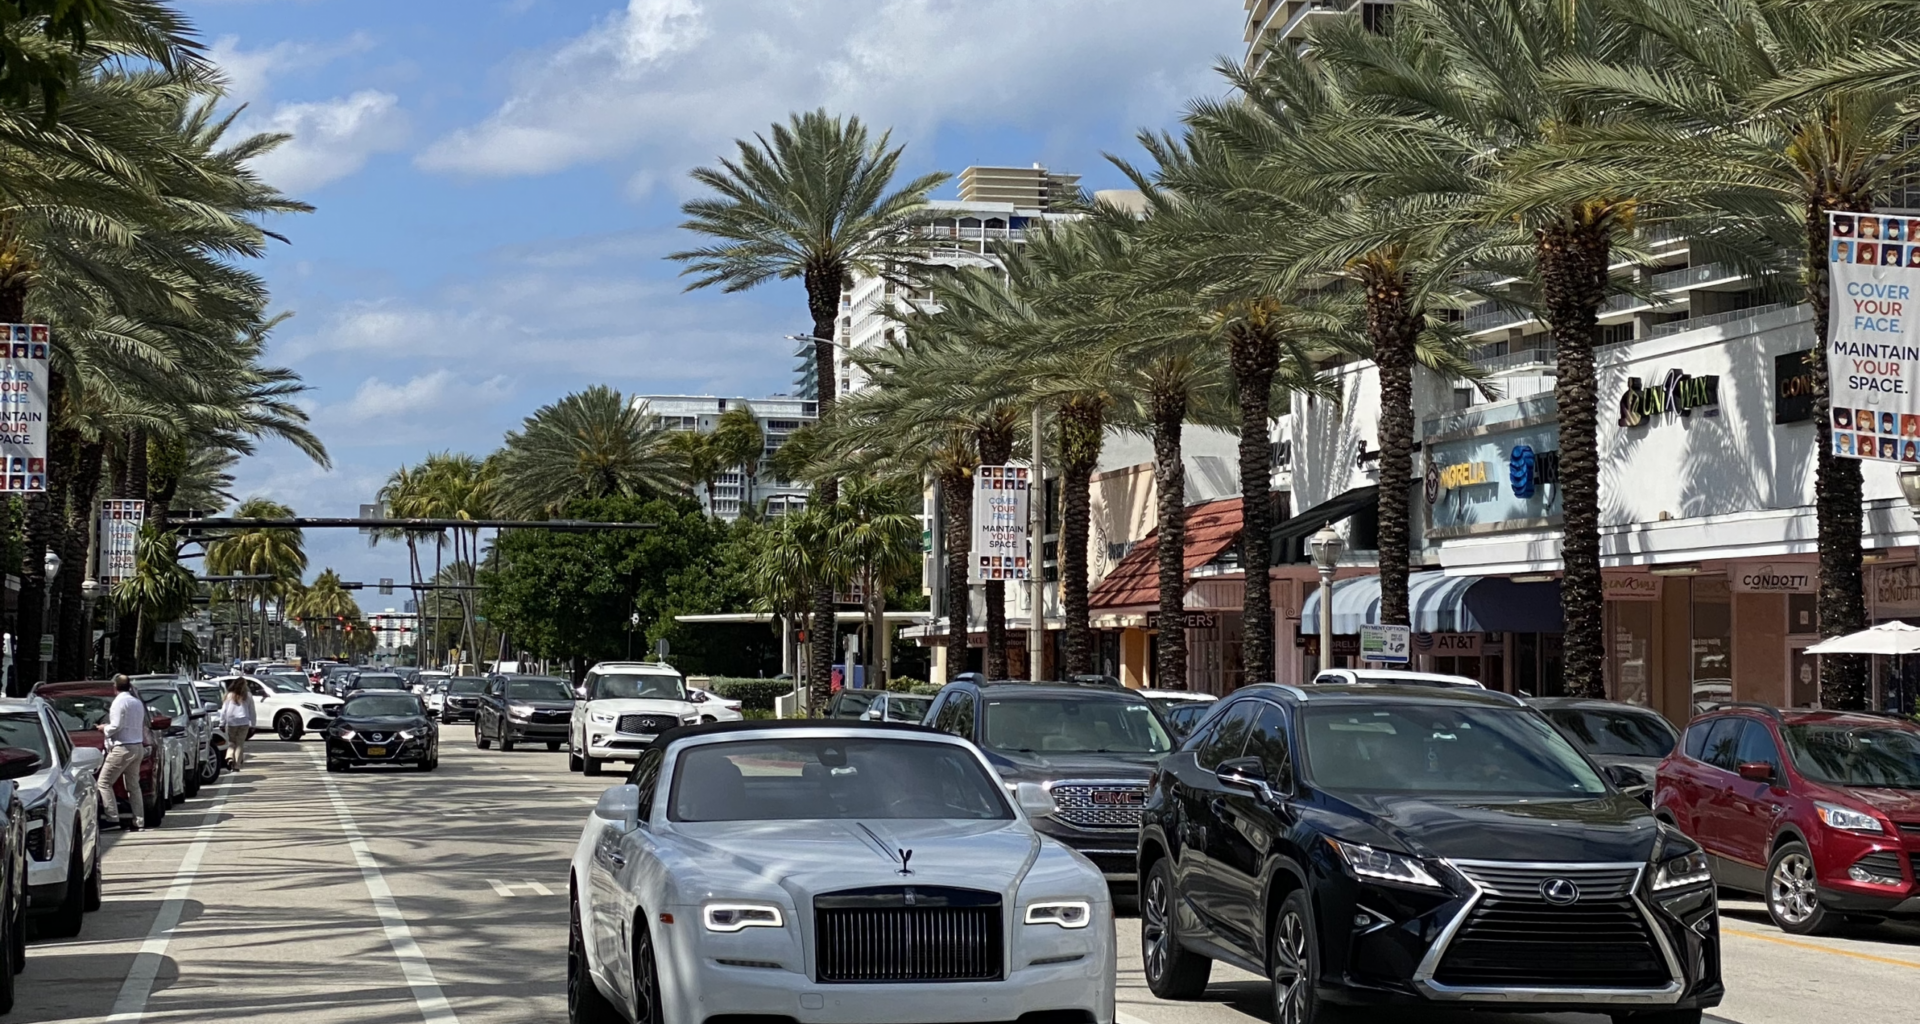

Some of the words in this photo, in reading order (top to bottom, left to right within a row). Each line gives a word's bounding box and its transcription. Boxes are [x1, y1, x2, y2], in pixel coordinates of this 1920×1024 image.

[1847, 281, 1910, 300] COVER
[1853, 298, 1903, 317] YOUR
[1854, 316, 1904, 334] FACE.
[1834, 341, 1920, 361] MAINTAIN
[1852, 359, 1900, 377] YOUR
[0, 370, 34, 381] OVER
[0, 381, 29, 392] OUR
[1848, 375, 1909, 395] SPACE.
[0, 393, 31, 404] ACE.
[0, 411, 42, 422] NTAIN
[0, 422, 28, 433] OUR
[0, 434, 34, 445] ACE.
[1532, 451, 1558, 485] AT&
[988, 497, 1019, 505] COVER
[992, 505, 1016, 513] YOUR
[982, 525, 1024, 533] MAINTAIN
[991, 533, 1016, 541] YOUR
[1742, 574, 1809, 587] CONDOTTI
[1148, 614, 1214, 628] FERS
[1330, 640, 1360, 648] ORELI
[1437, 635, 1477, 649] AT&T
[1093, 791, 1143, 804] GMC
